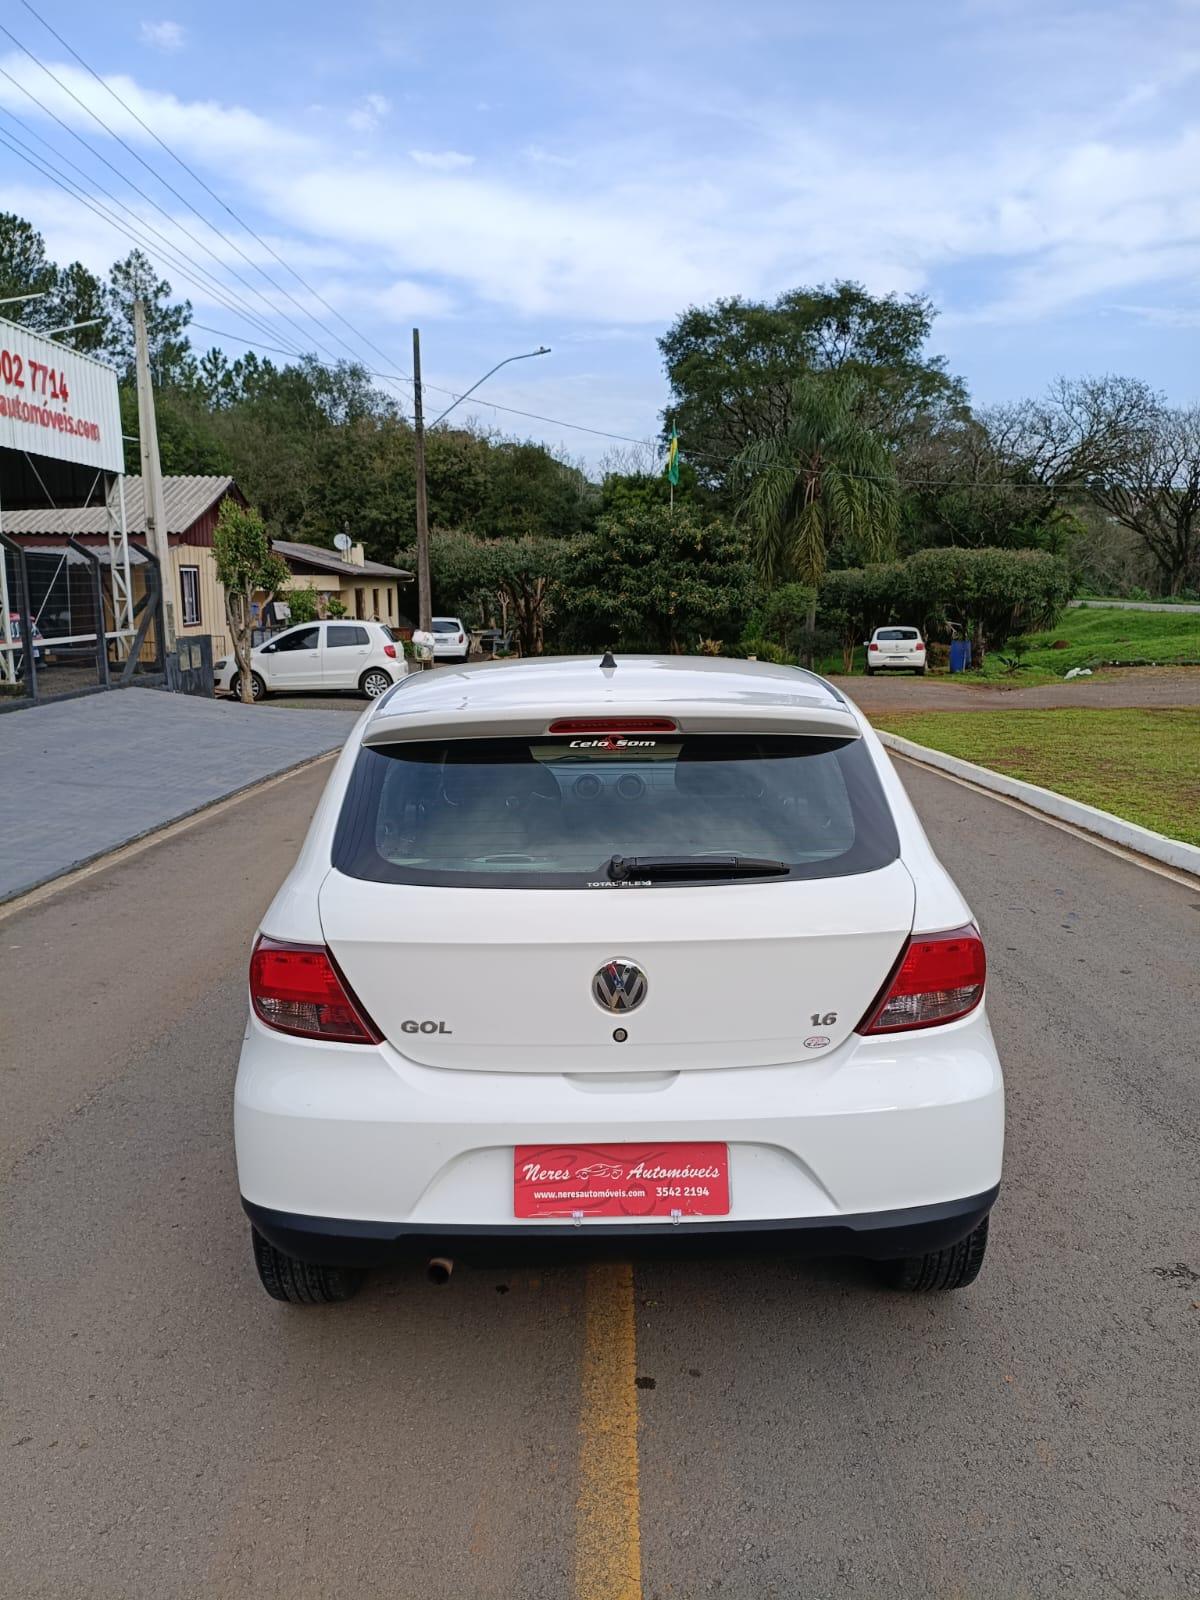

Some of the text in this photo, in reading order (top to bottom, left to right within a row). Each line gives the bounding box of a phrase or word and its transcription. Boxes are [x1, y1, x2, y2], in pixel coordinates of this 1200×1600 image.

[0, 349, 69, 403] 02 7714
[615, 739, 656, 747] Som
[592, 958, 648, 1013] VW
[400, 1020, 452, 1034] GOL
[522, 1162, 720, 1181] Neres Automóveis
[533, 1186, 709, 1199] www.neresautomóveis.com 3542 2194
